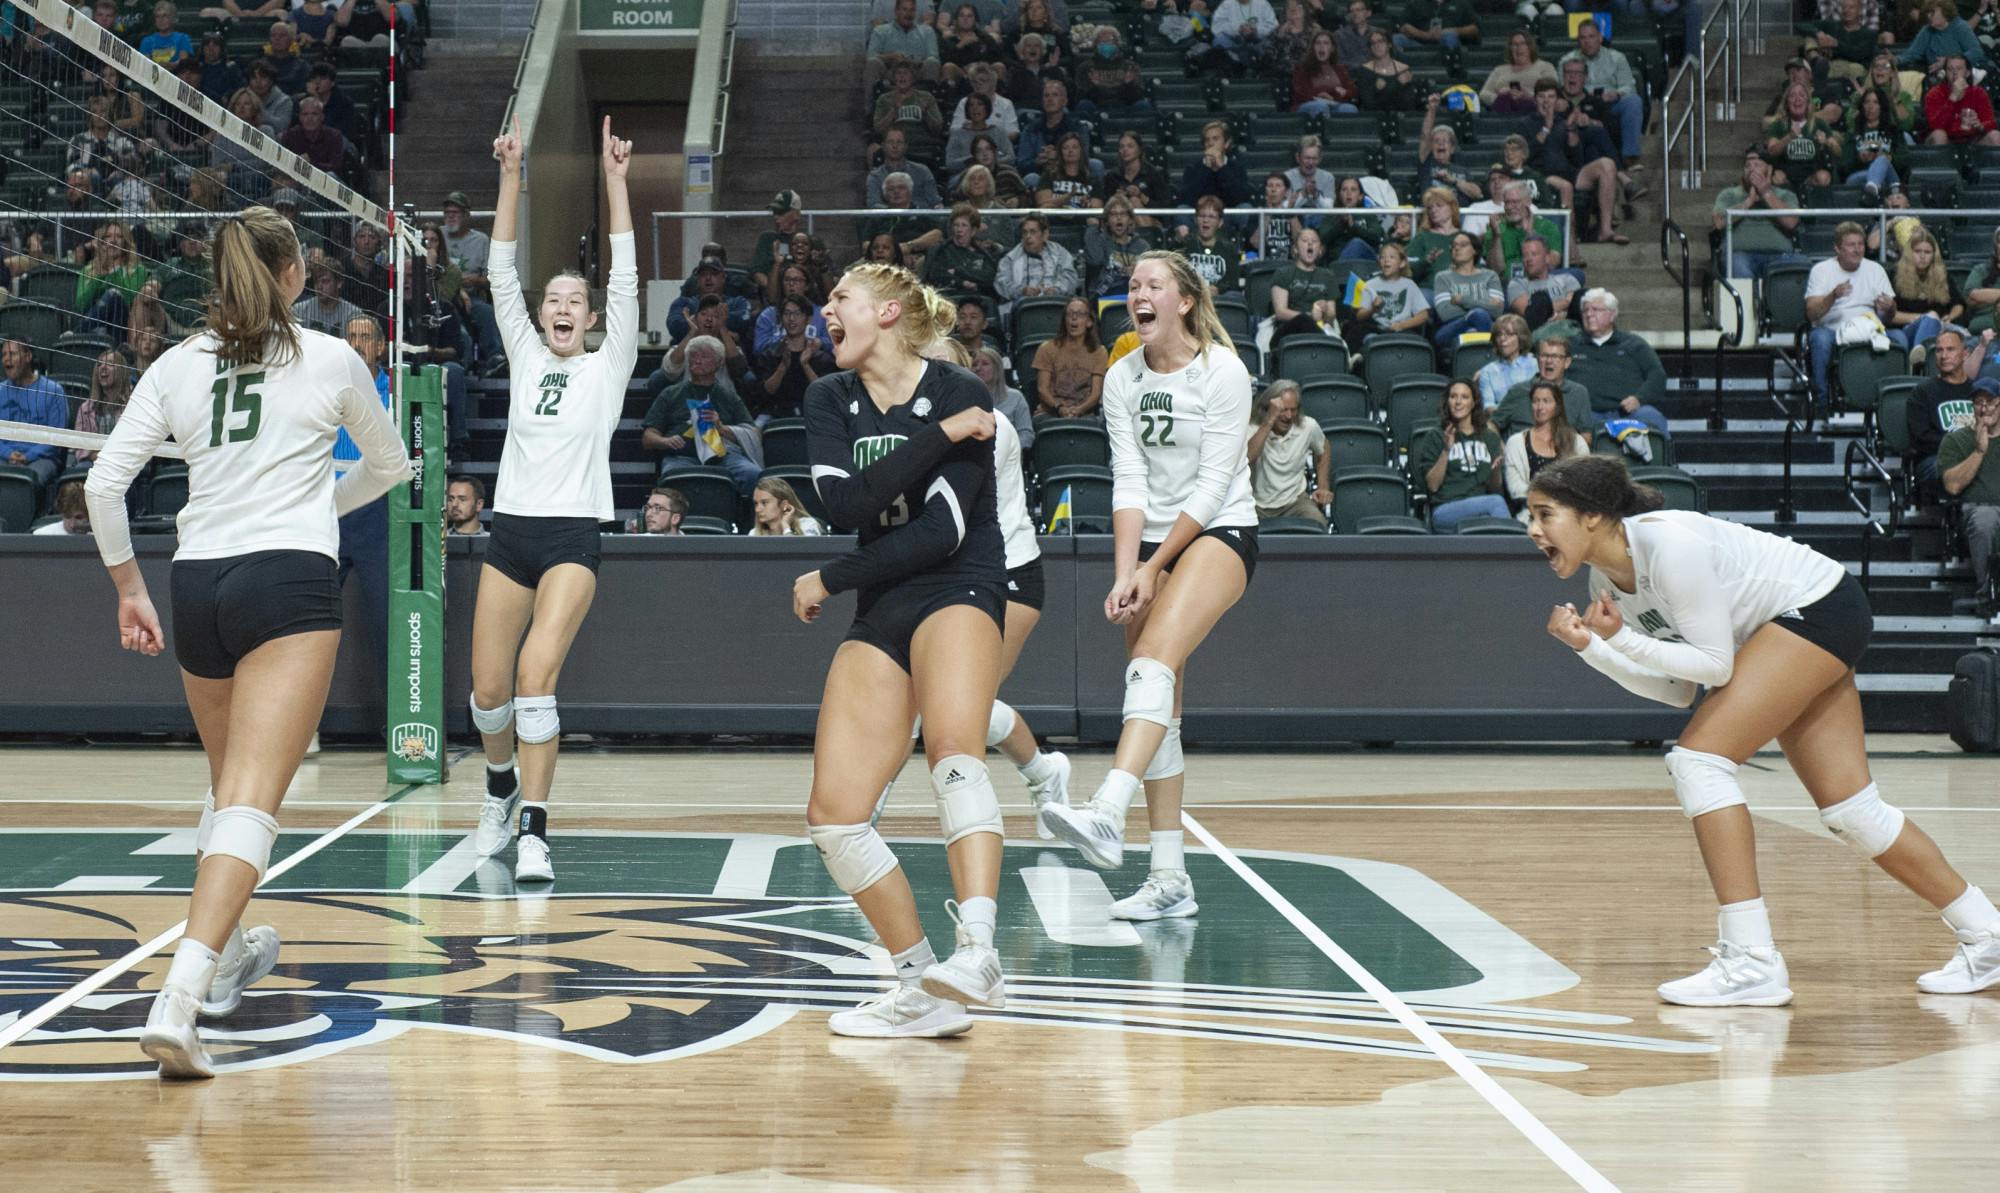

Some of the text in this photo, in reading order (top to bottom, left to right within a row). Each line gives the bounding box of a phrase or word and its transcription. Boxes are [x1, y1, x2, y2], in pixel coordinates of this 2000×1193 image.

[612, 10, 673, 25] ROOM
[209, 371, 266, 448] 15
[535, 389, 563, 416] 12
[1140, 391, 1173, 413] OHIO
[413, 415, 423, 449] sports
[1140, 414, 1176, 447] 22
[408, 612, 423, 713] sports imports
